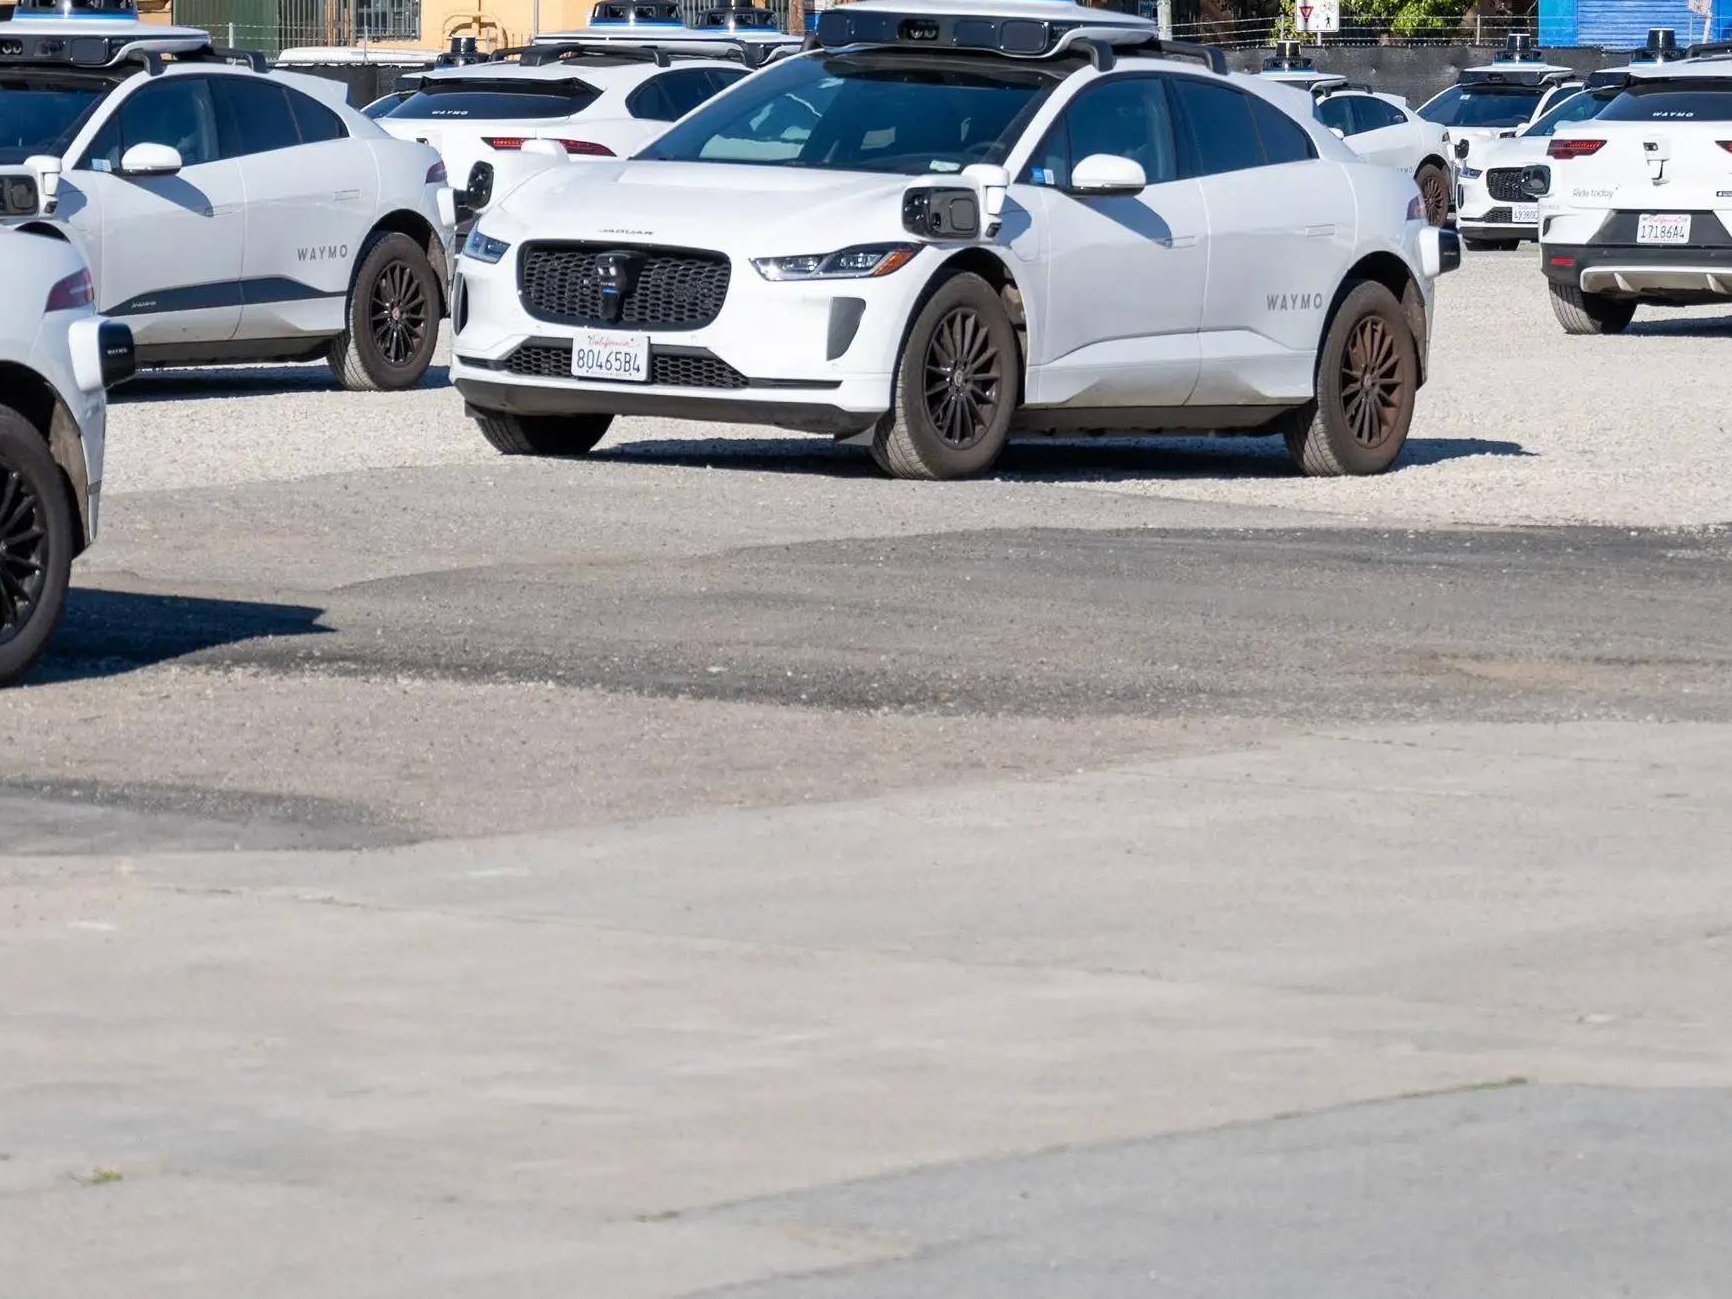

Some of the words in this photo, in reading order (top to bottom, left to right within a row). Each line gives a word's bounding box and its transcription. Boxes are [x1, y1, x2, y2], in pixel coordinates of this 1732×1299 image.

[431, 109, 469, 117] WAYMO
[1572, 187, 1590, 199] Ride
[1591, 187, 1615, 201] today
[1639, 224, 1685, 239] 17186A4
[296, 243, 350, 262] WAYMO
[1266, 293, 1323, 311] WAYMO
[587, 334, 634, 349] California
[576, 348, 641, 374] 80465B4
